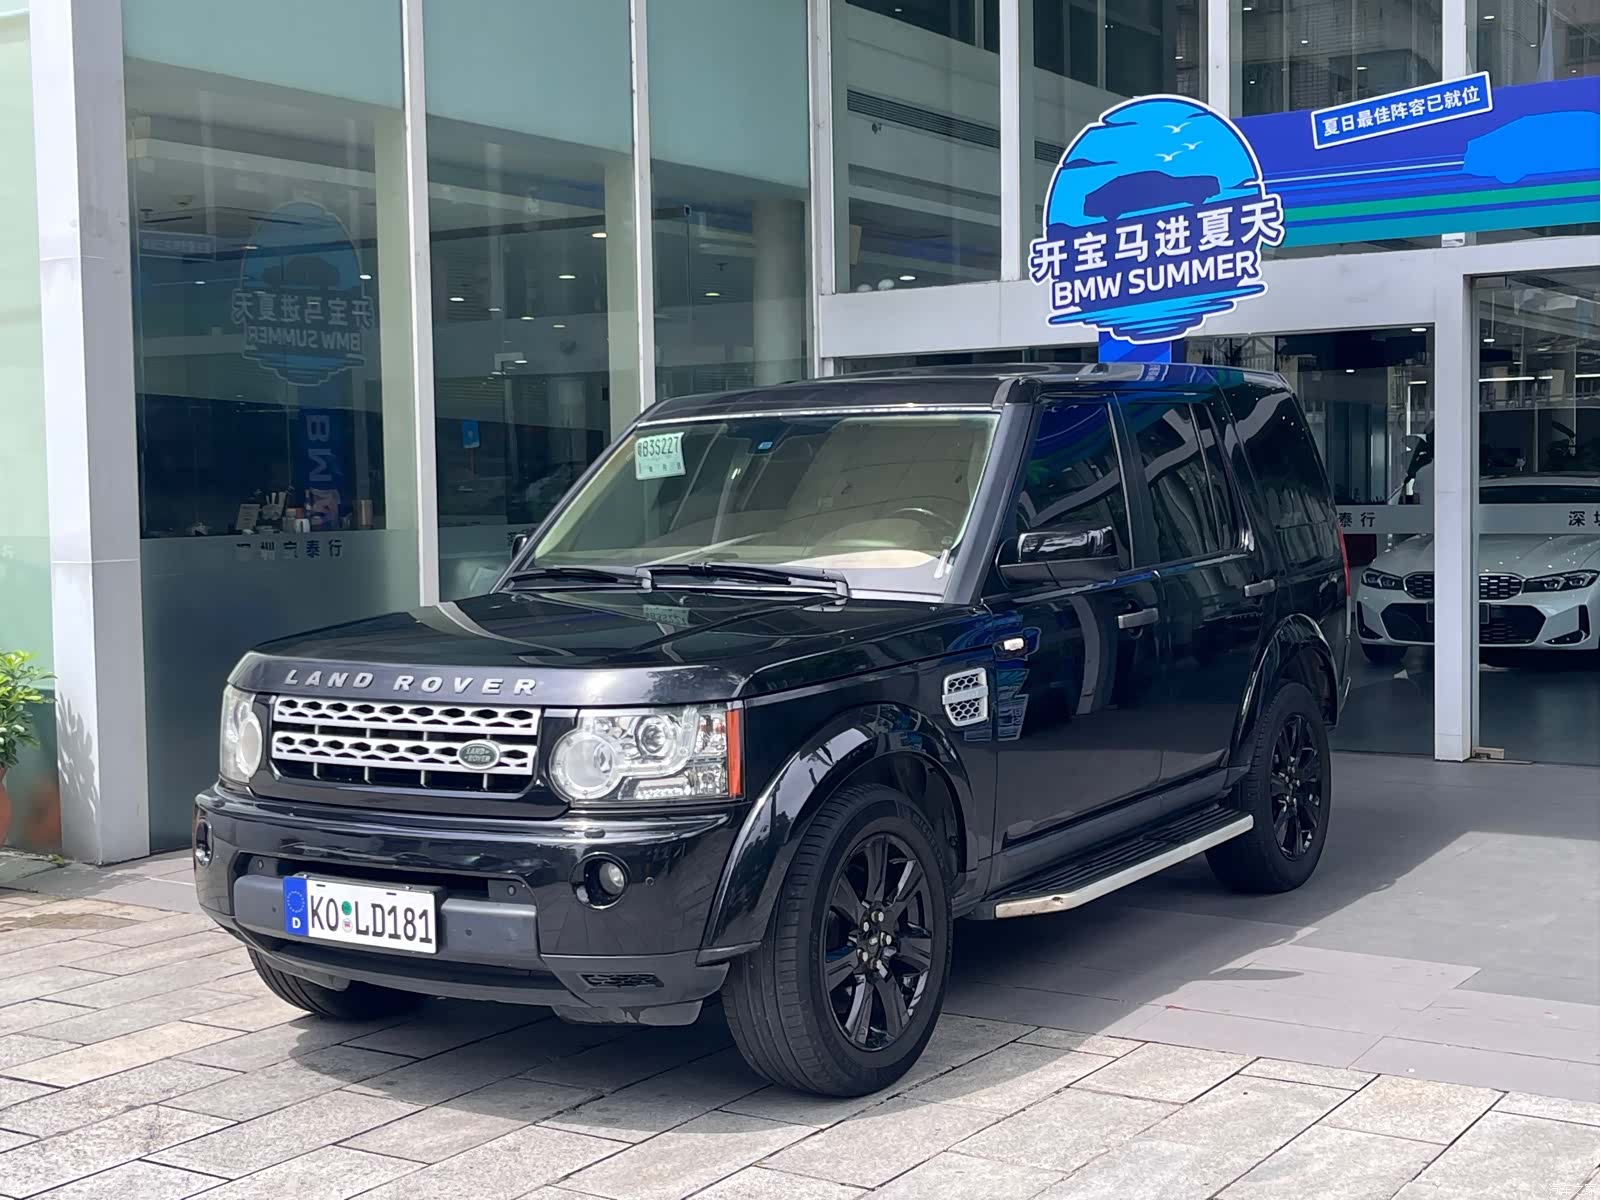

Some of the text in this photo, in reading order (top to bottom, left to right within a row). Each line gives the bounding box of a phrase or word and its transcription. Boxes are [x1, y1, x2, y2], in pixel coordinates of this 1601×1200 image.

[1322, 86, 1480, 137] 夏日最佳阵容已就位
[1032, 199, 1281, 280] 开宝马进夏天
[1054, 250, 1257, 307] BMW SUMMER
[284, 669, 537, 696] LAND ROVER
[465, 747, 486, 755] LAND
[292, 917, 302, 929] D
[310, 895, 433, 944] KO LD181
